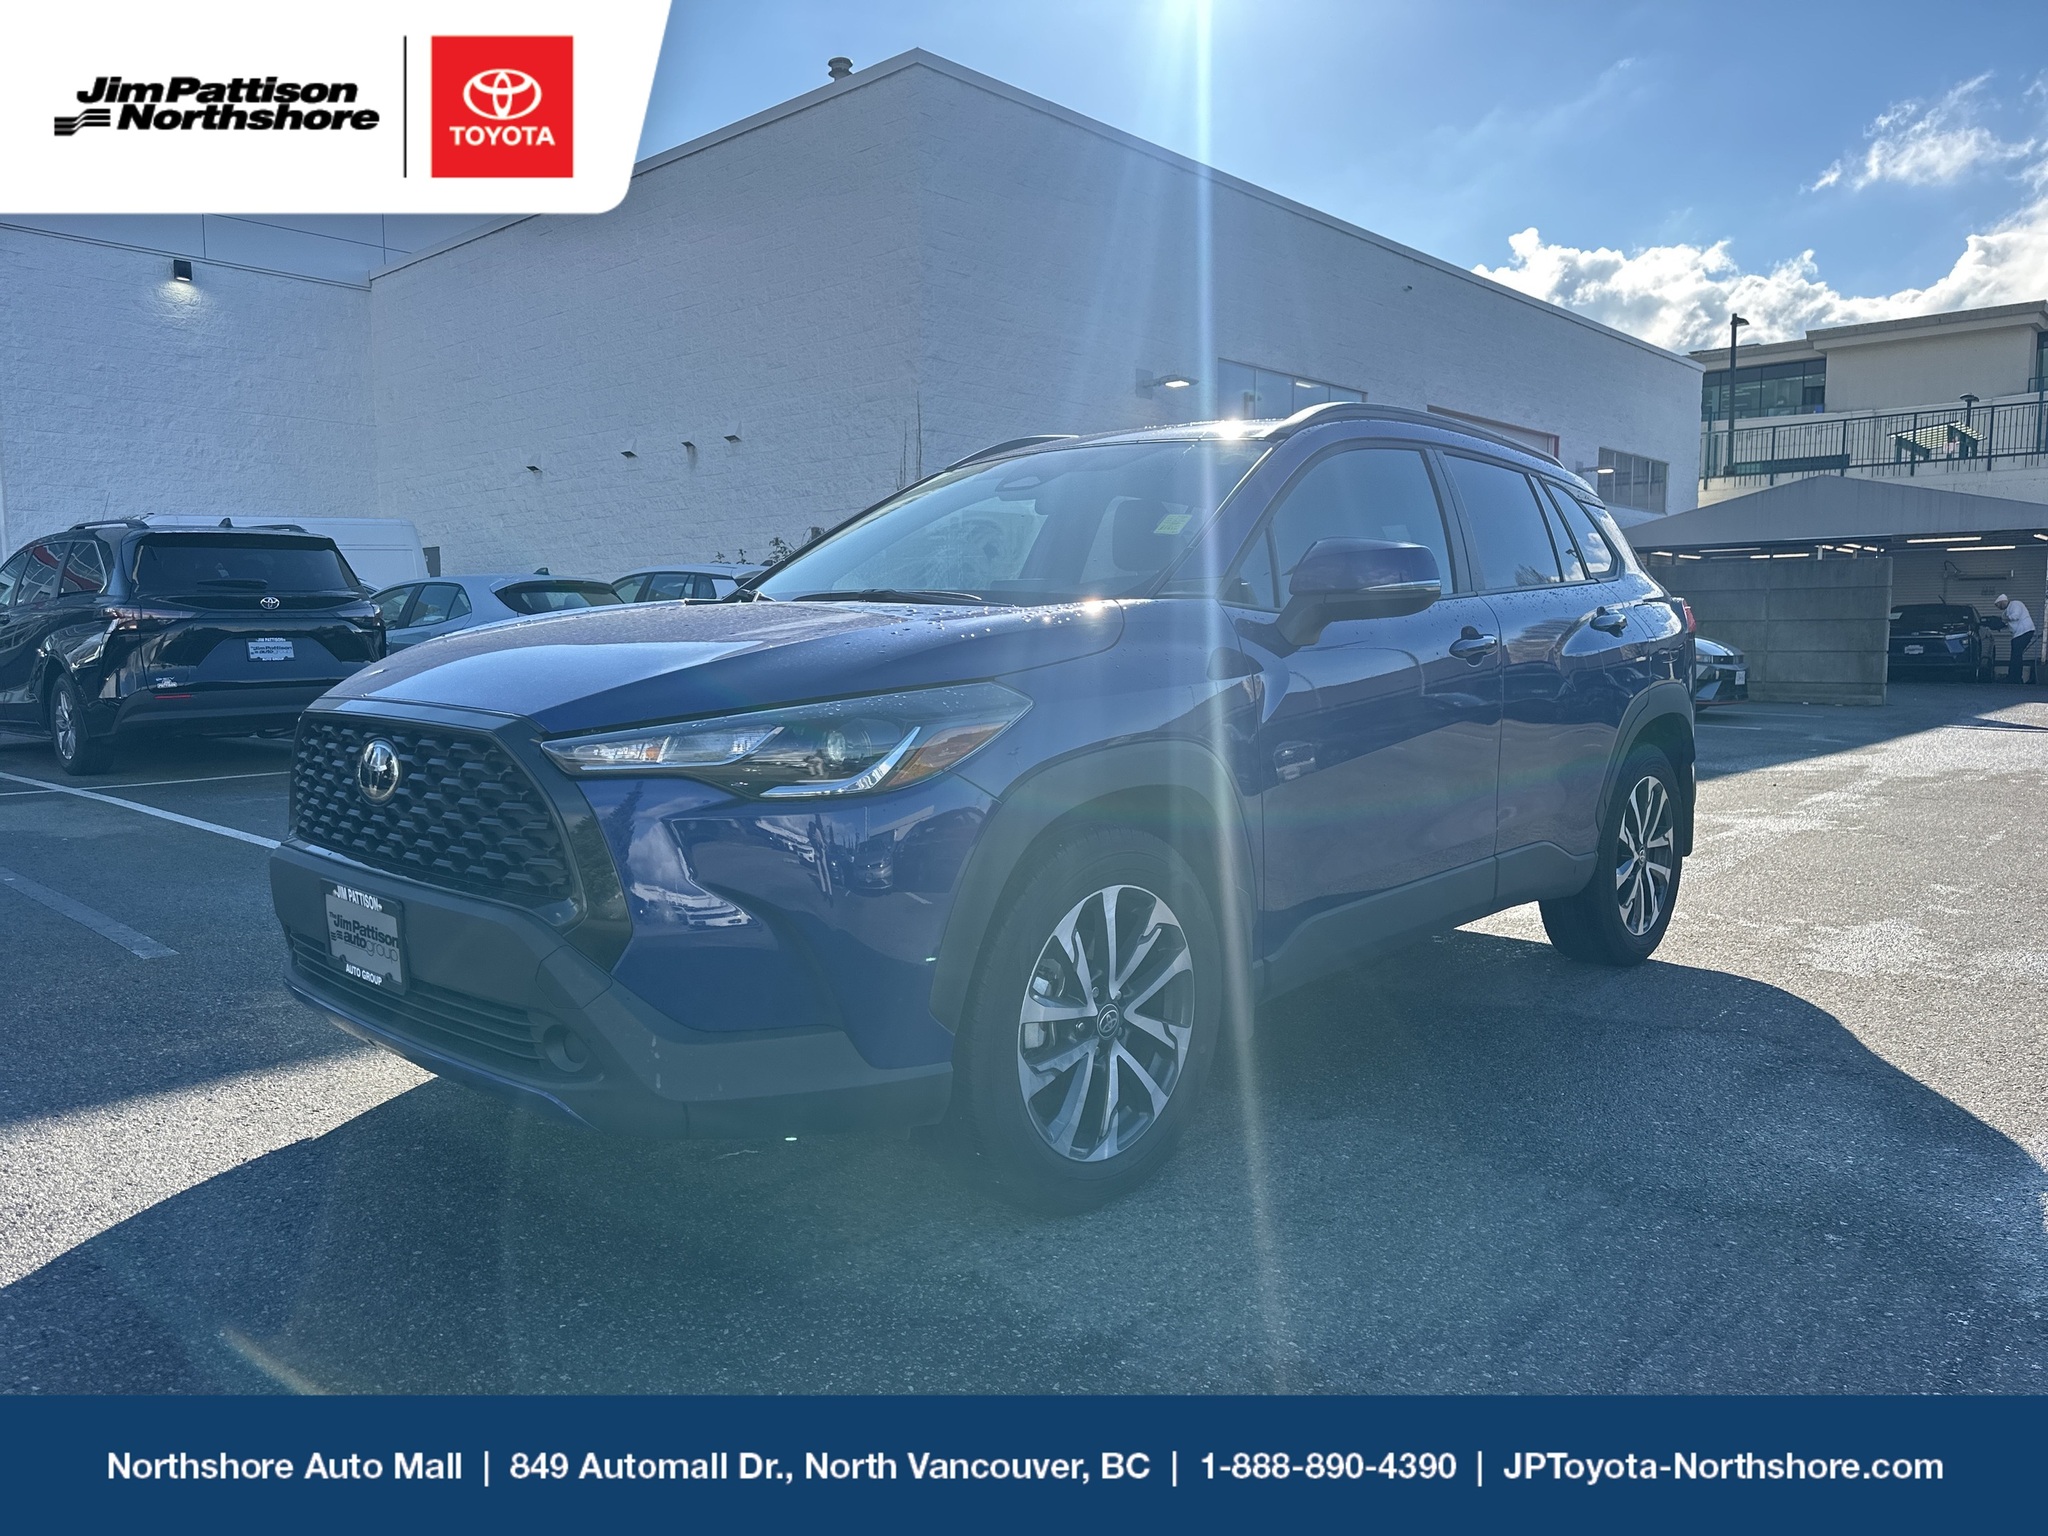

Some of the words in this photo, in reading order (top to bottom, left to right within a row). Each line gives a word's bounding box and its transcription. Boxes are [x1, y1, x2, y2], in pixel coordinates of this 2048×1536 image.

[336, 885, 348, 901] JIM
[348, 888, 380, 912] PATTISON
[345, 963, 361, 978] AUTO
[361, 969, 383, 986] GROUP
